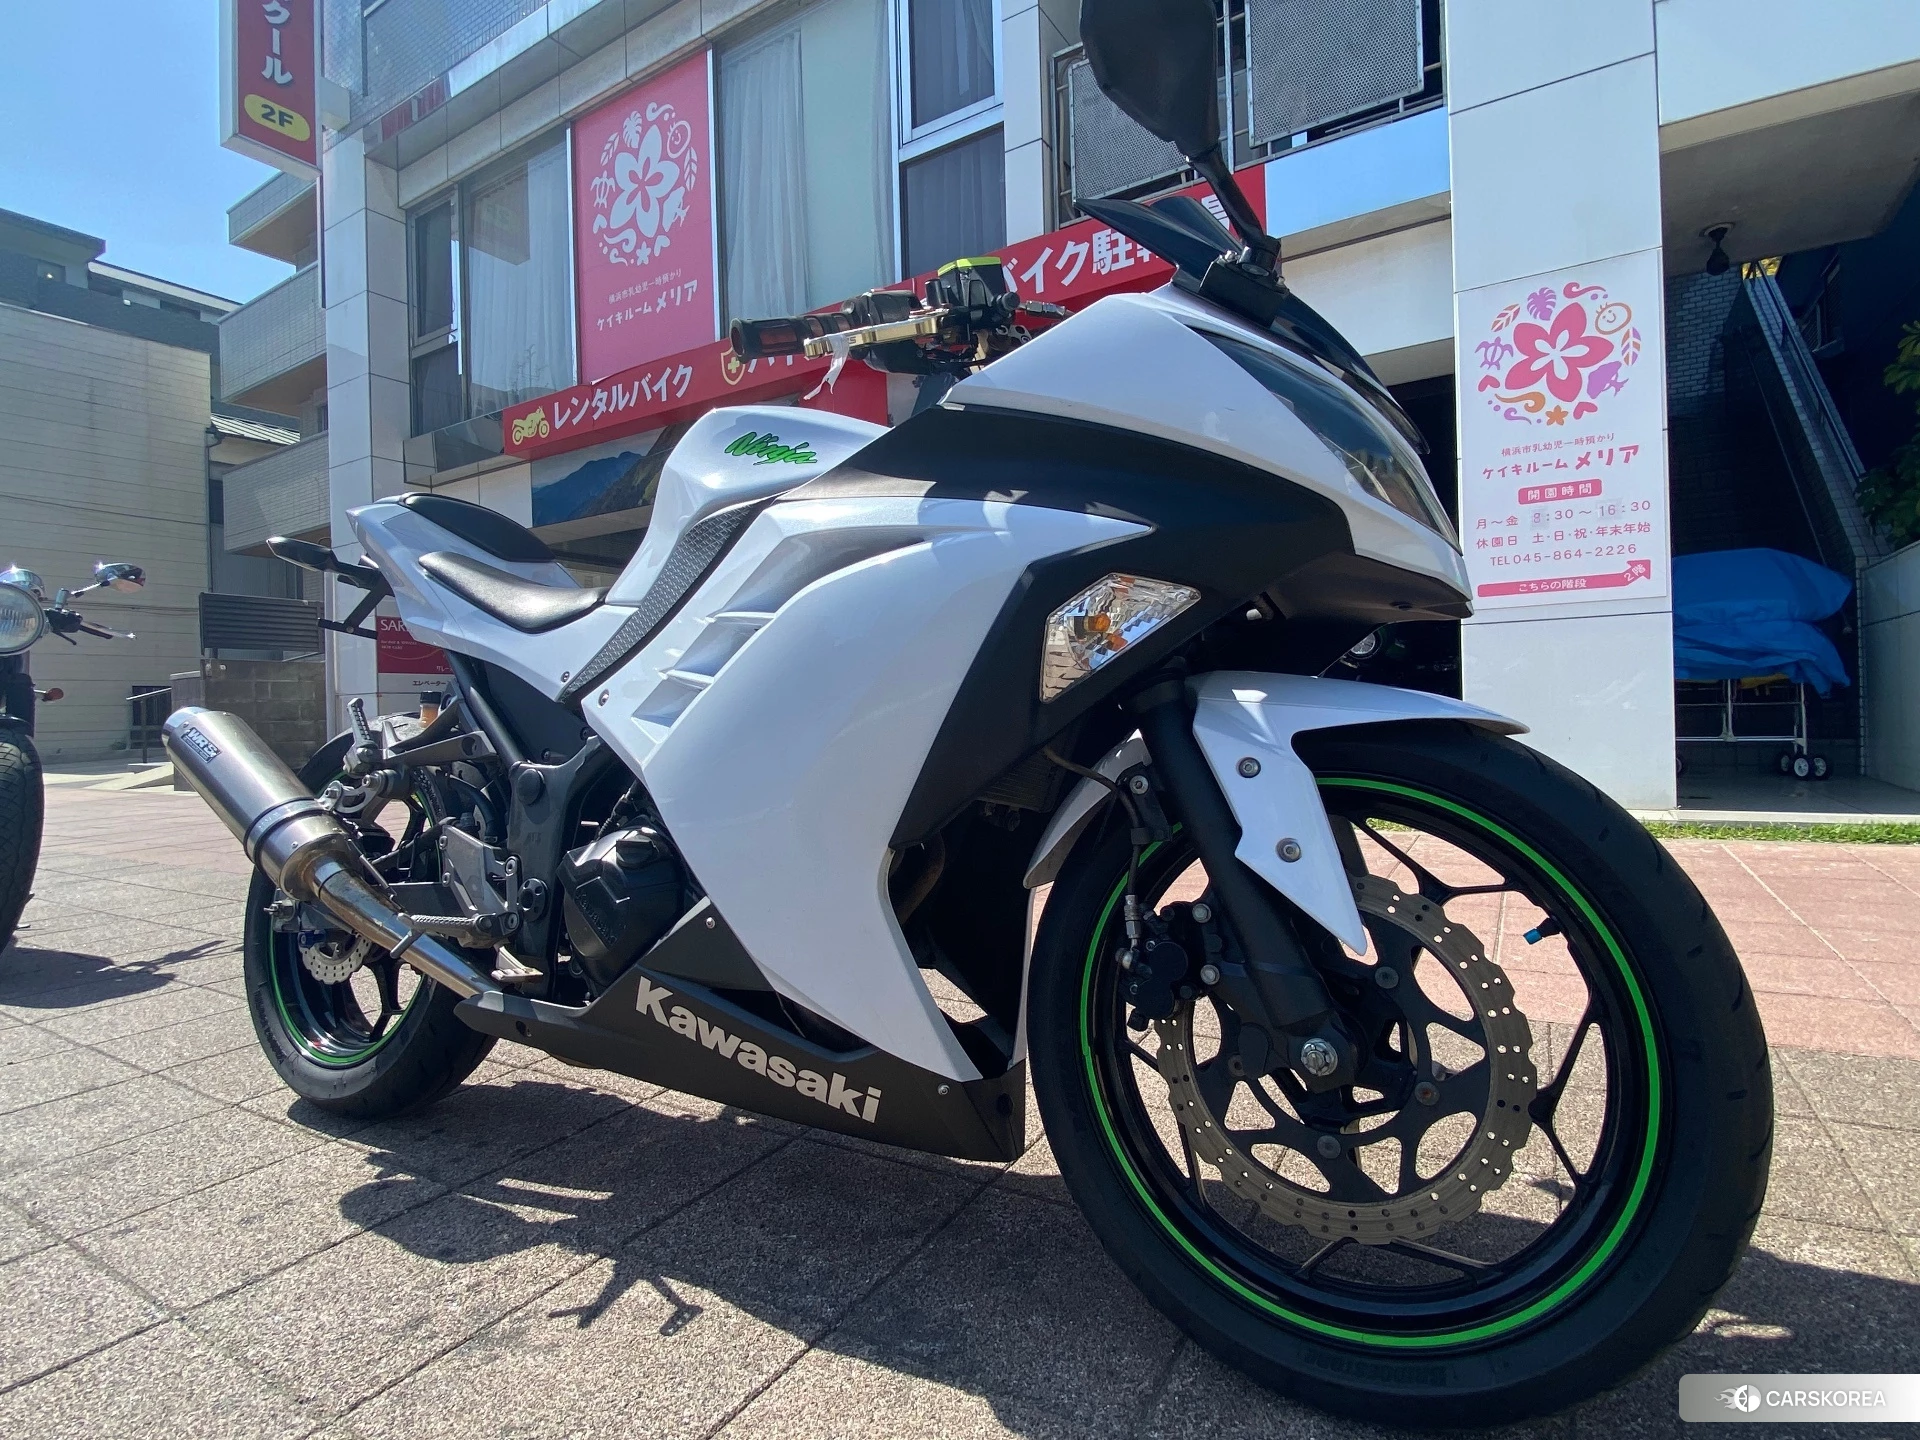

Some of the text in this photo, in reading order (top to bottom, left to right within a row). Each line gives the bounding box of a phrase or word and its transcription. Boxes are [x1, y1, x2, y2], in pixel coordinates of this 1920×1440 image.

[261, 104, 294, 127] 2F
[597, 280, 698, 331] ケイキルーム メリア
[554, 364, 693, 429] レンタルバイク
[724, 431, 818, 465] Ninja
[1501, 433, 1615, 457] 横浜市乳幼児一時預かり
[1482, 445, 1639, 479] ケイキルーム メリア
[1527, 483, 1592, 501] 開園時間
[1476, 535, 1518, 549] 休園日
[1519, 579, 1587, 592] こちらの階段
[635, 976, 882, 1123] Kawasaki
